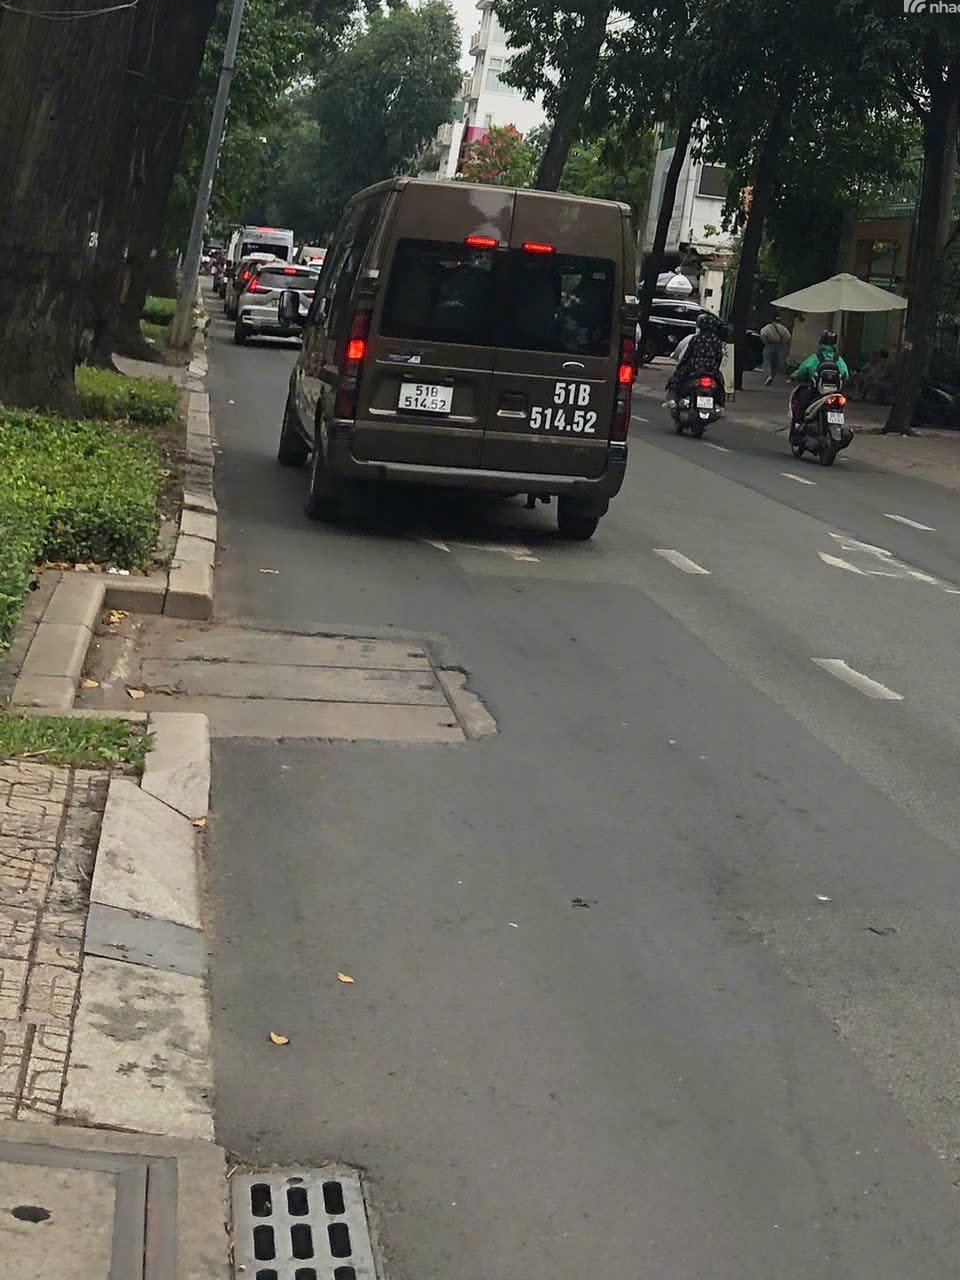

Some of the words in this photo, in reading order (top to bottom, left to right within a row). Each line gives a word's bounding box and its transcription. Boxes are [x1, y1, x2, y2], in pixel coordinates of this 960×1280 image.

[416, 386, 438, 398] 51B
[554, 382, 591, 406] 51B
[405, 397, 447, 411] 514.52
[529, 407, 598, 433] 514.52
